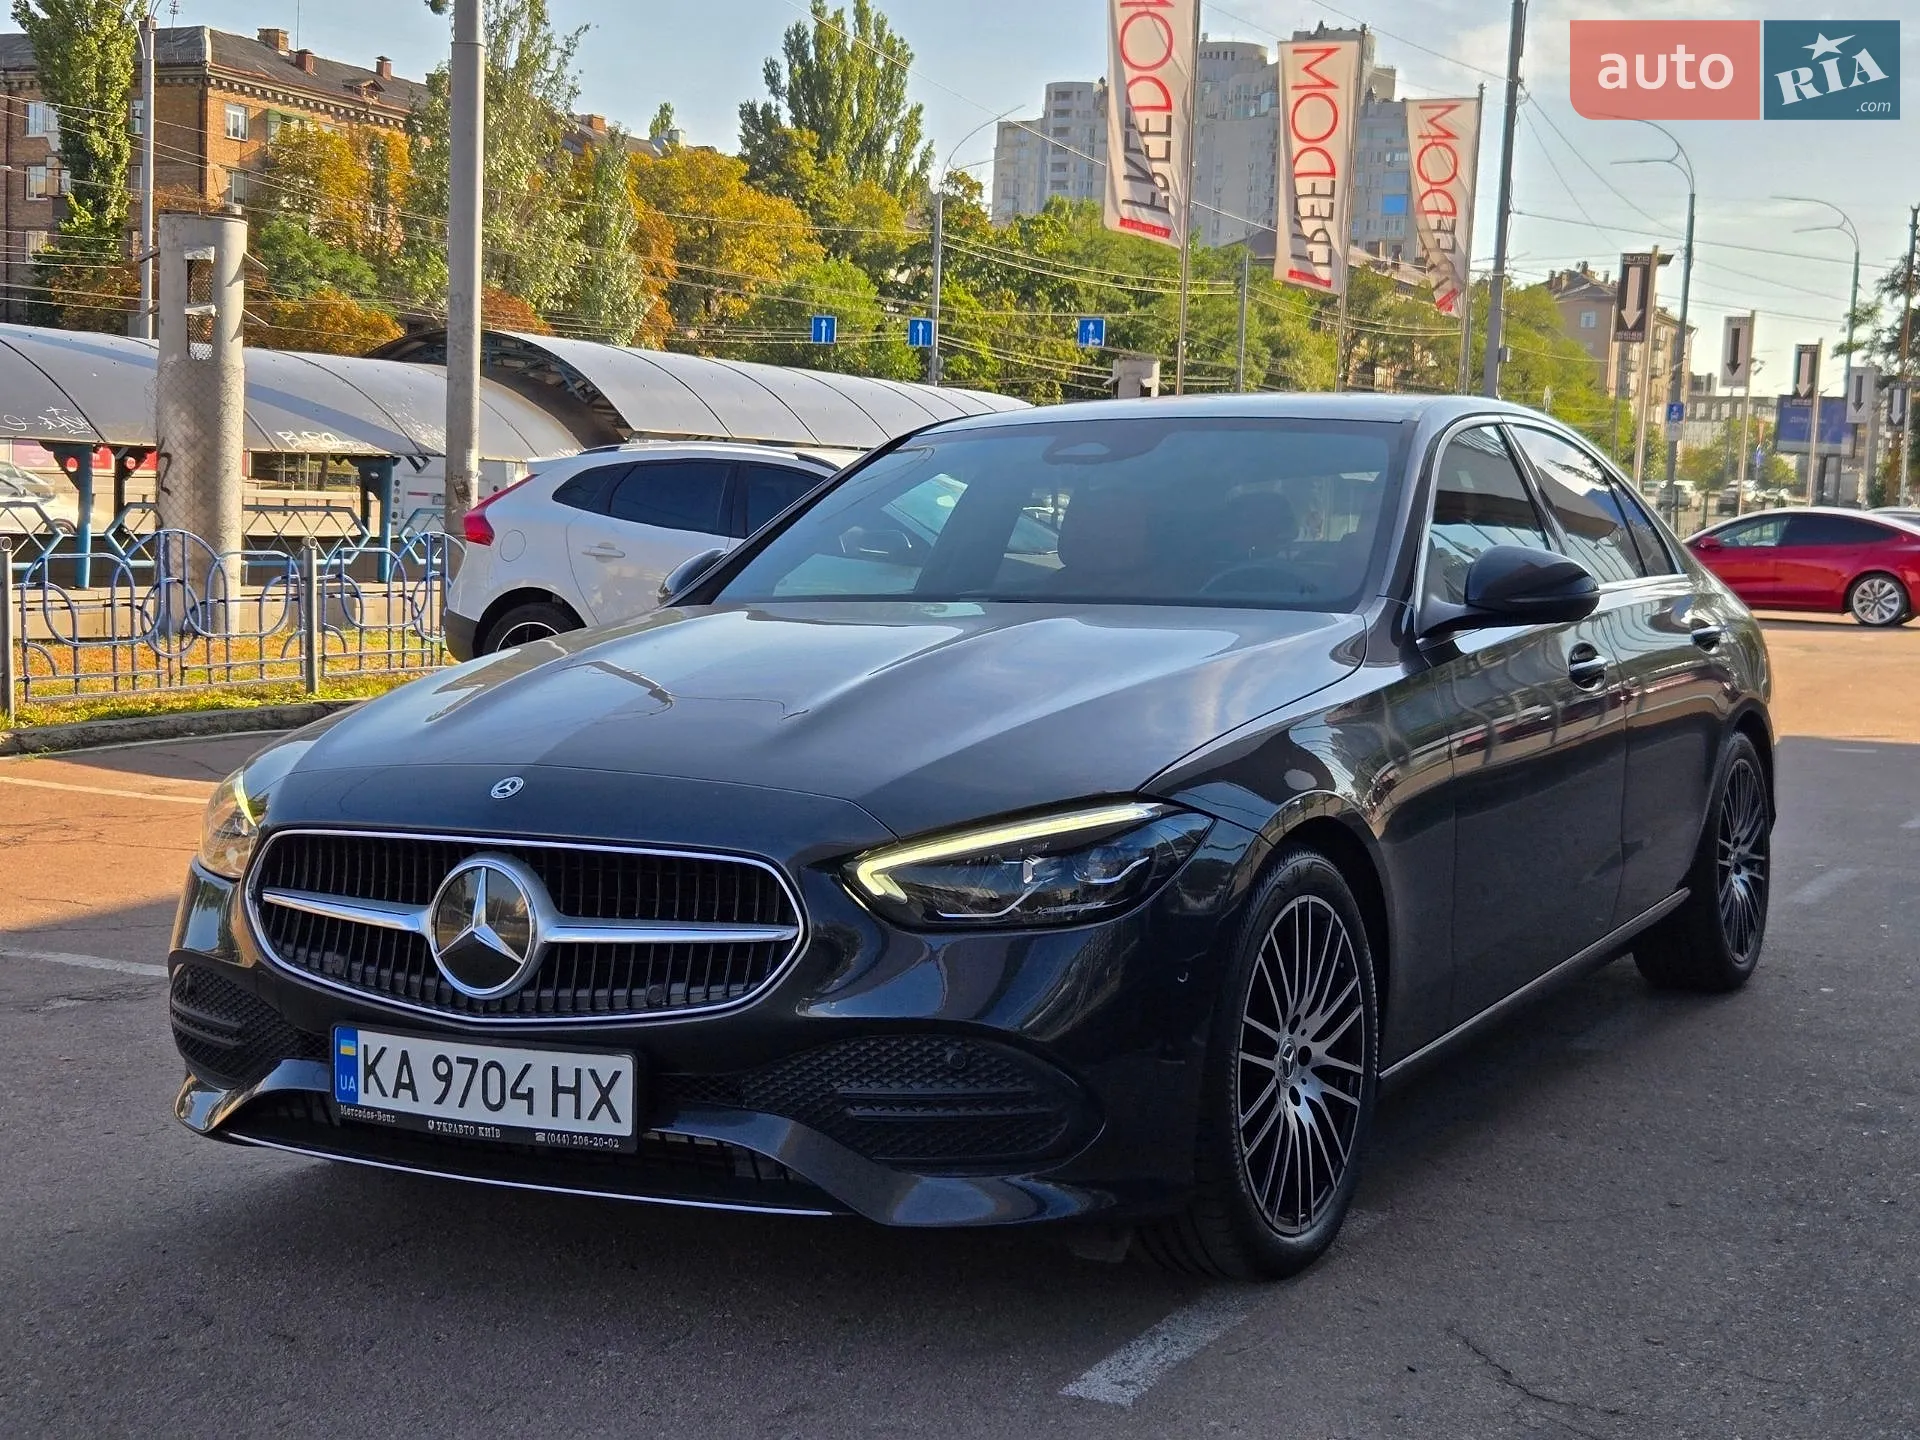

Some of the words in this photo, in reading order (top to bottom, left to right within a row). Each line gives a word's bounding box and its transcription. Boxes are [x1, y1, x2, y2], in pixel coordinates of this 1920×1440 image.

[340, 1074, 356, 1092] UA
[363, 1043, 419, 1102] KA
[432, 1054, 534, 1116] 9704
[551, 1065, 622, 1123] HX
[340, 1105, 396, 1123] Mercedes-Benz
[436, 1121, 475, 1136] УКРАВТО
[547, 1132, 570, 1146] (044)
